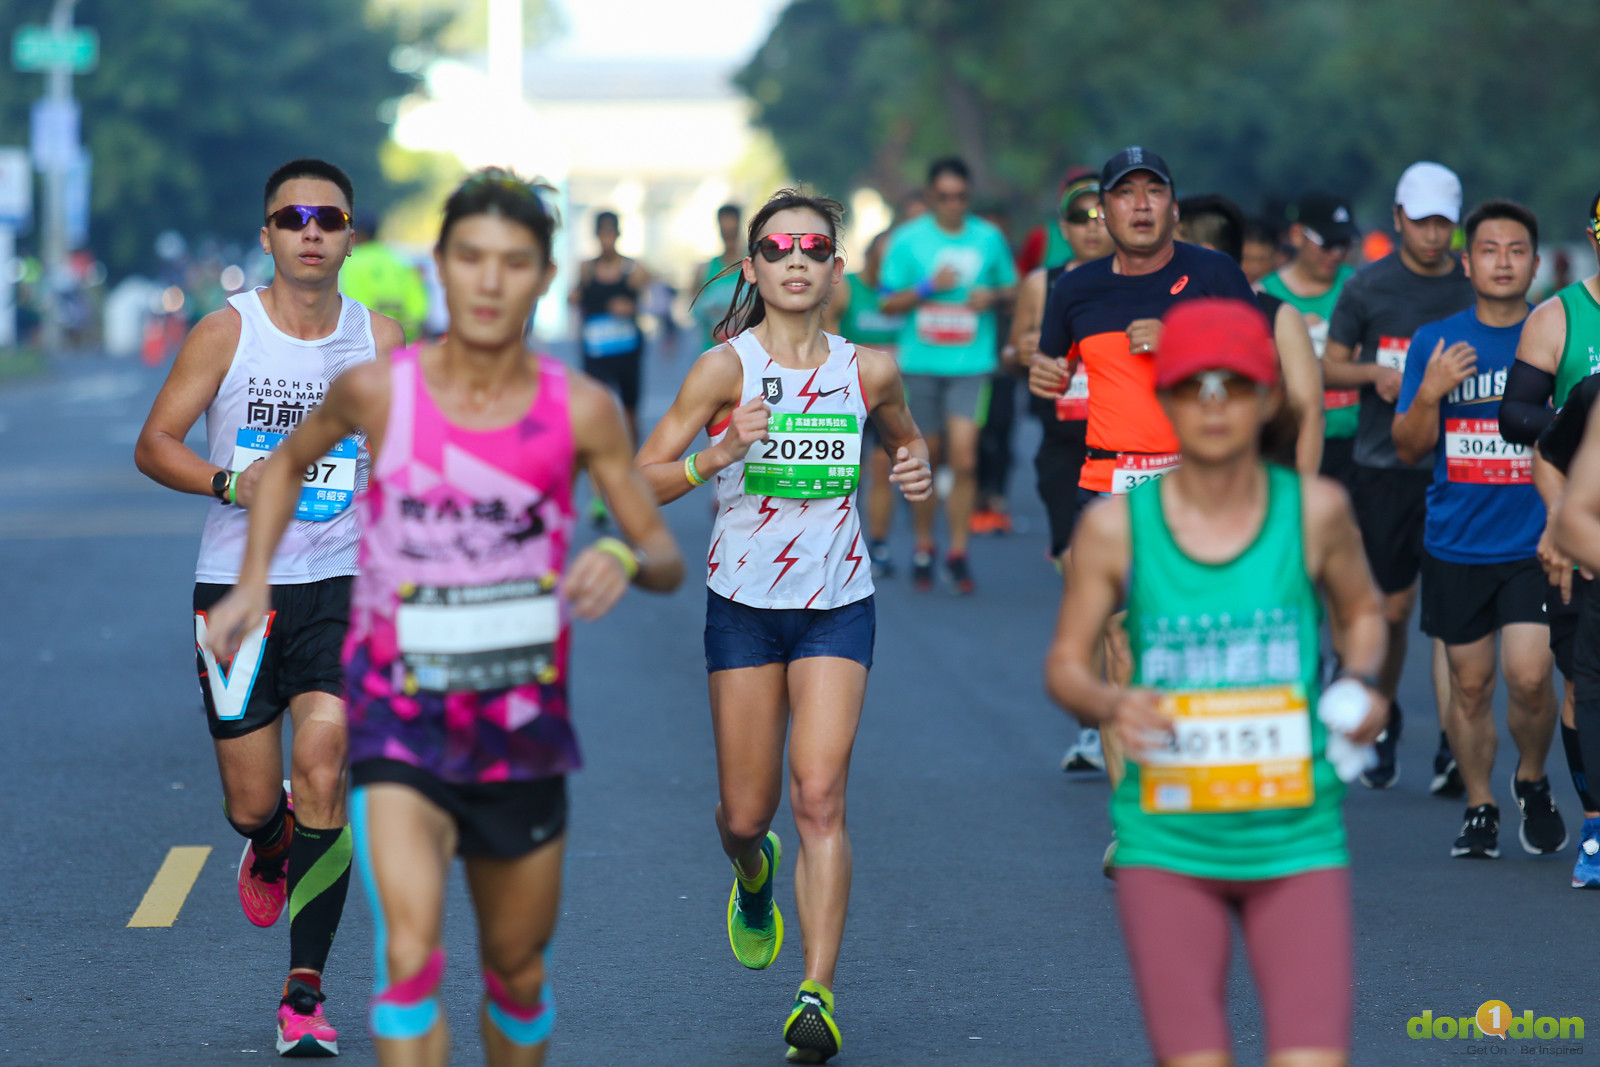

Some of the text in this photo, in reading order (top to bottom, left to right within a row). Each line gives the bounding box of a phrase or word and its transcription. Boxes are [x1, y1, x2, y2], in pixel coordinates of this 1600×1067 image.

[248, 387, 291, 399] FUBON
[247, 398, 320, 428] 向前
[762, 439, 845, 460] 20298
[1459, 439, 1524, 455] 30470
